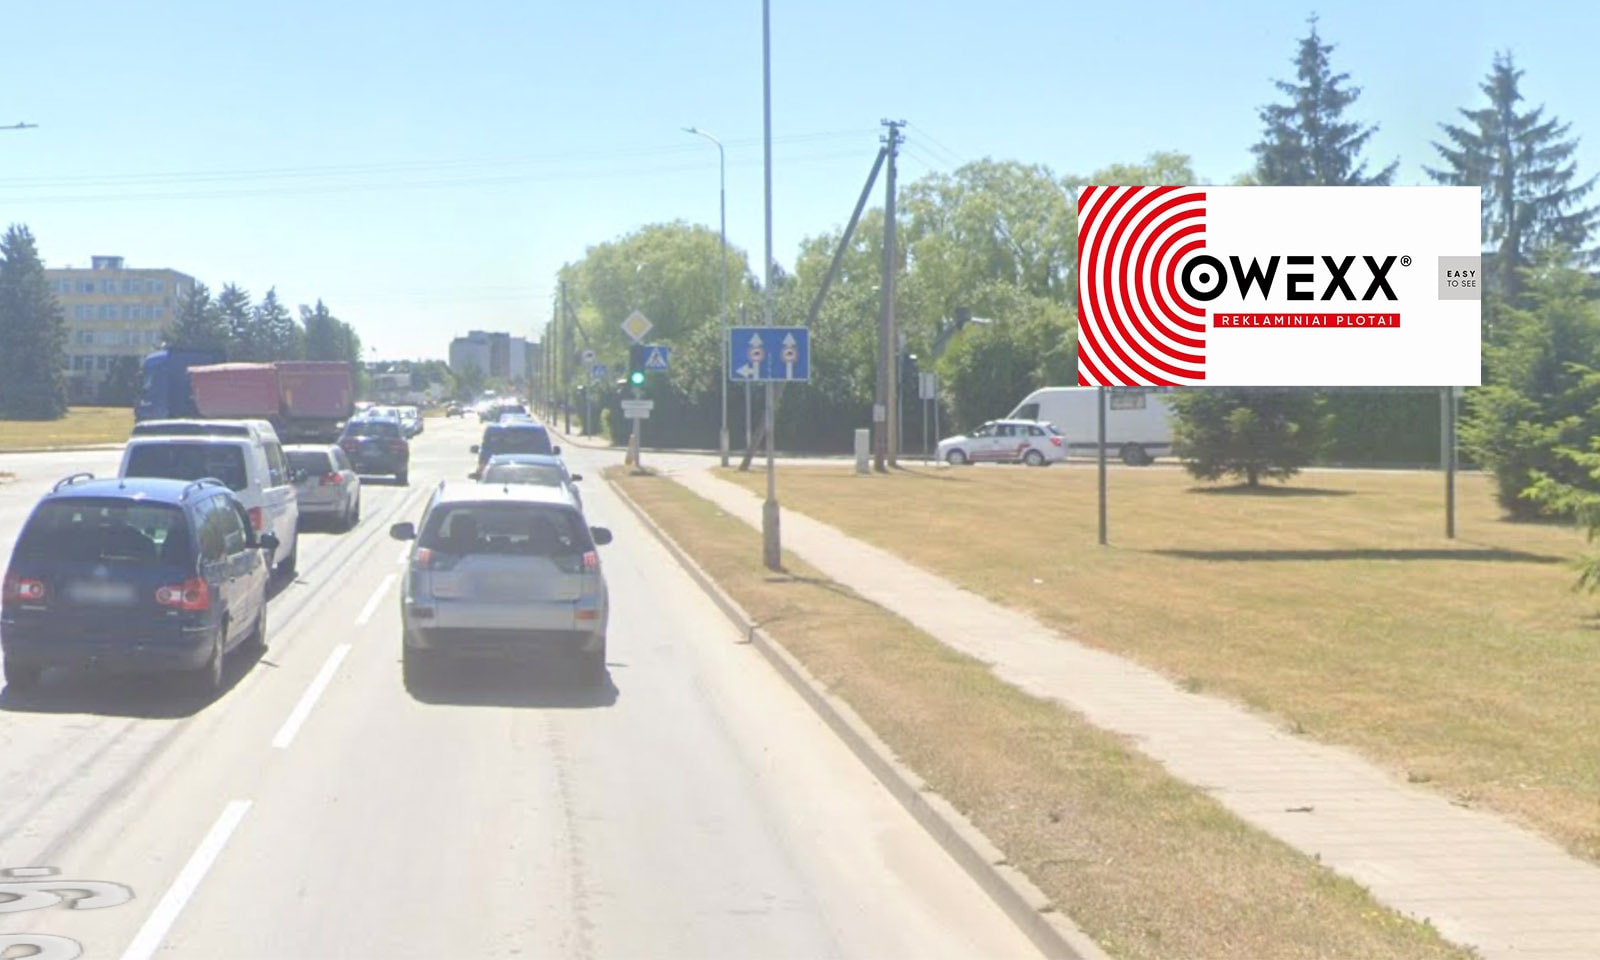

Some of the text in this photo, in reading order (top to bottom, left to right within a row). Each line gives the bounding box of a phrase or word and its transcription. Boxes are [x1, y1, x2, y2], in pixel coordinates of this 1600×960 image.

[1446, 270, 1476, 278] EASY
[1446, 279, 1476, 288] TO SEE
[1221, 315, 1393, 326] REKLAMINIAI PLOTAI
